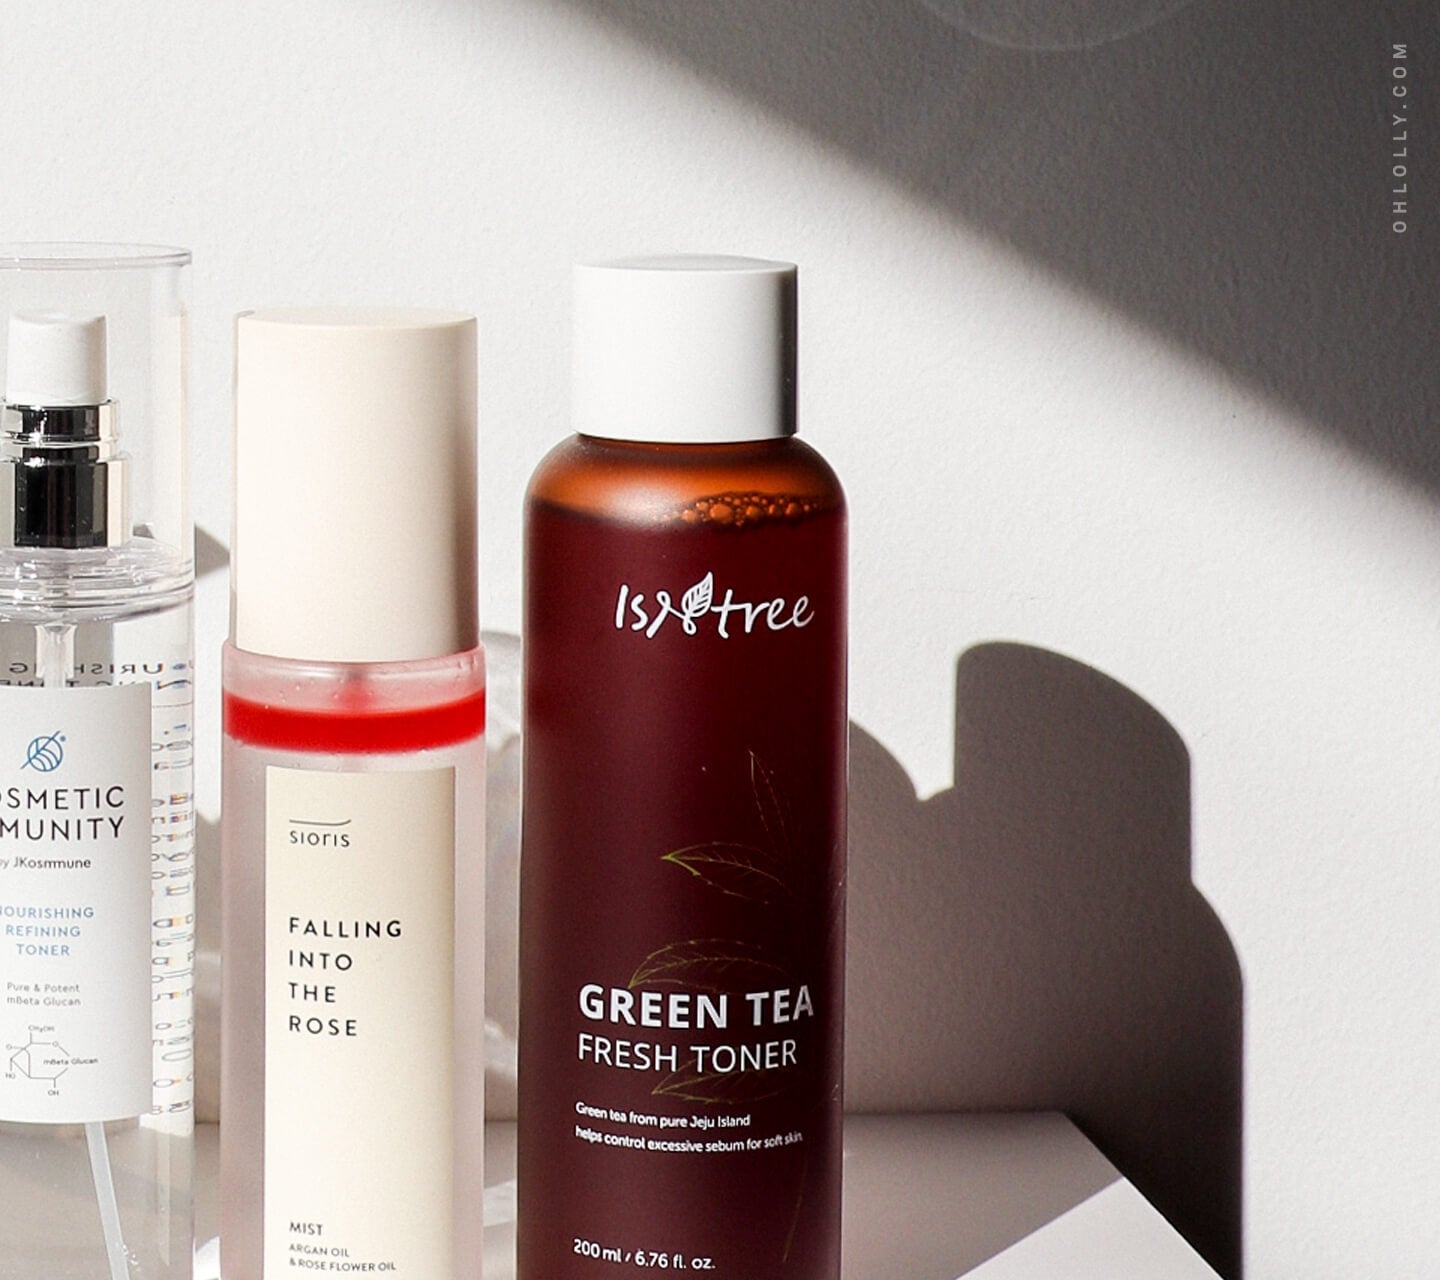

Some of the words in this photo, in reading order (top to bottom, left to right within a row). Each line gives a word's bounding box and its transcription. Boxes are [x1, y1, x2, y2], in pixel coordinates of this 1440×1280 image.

[5, 924, 81, 938] REFINING
[289, 917, 402, 938] FALLING
[16, 944, 70, 956] TONER
[289, 949, 353, 971] INTO
[7, 982, 30, 993] Pure
[34, 983, 41, 993] &
[44, 983, 80, 993] Potent
[288, 982, 337, 1003] THE
[43, 996, 81, 1006] Glucan
[579, 984, 728, 1029] GREEN
[745, 984, 814, 1026] TEA
[289, 1015, 358, 1036] ROSE
[578, 1033, 678, 1072] FRESH
[690, 1038, 797, 1073] TONER
[575, 1101, 607, 1119] Green
[609, 1109, 627, 1123] tea
[629, 1111, 658, 1127] from
[660, 1116, 688, 1130] pure
[689, 1115, 715, 1130] Jeju
[717, 1114, 751, 1128] Island
[575, 1126, 603, 1145] helps
[604, 1132, 646, 1149] control
[647, 1140, 704, 1152] excessive
[705, 1139, 745, 1152] sebum
[746, 1138, 762, 1150] for
[763, 1134, 784, 1148] soft
[784, 1132, 803, 1145] skin
[289, 1222, 323, 1236] MIST
[289, 1243, 327, 1256] ARGAN
[331, 1247, 350, 1258] OIL
[573, 1238, 601, 1259] 200
[602, 1247, 622, 1263] ml
[635, 1249, 669, 1268] 6.76
[673, 1252, 687, 1269] fl.
[692, 1257, 716, 1270] oz.
[298, 1259, 326, 1271] ROSE
[329, 1262, 376, 1272] FLOWER
[378, 1262, 397, 1271] OIL
